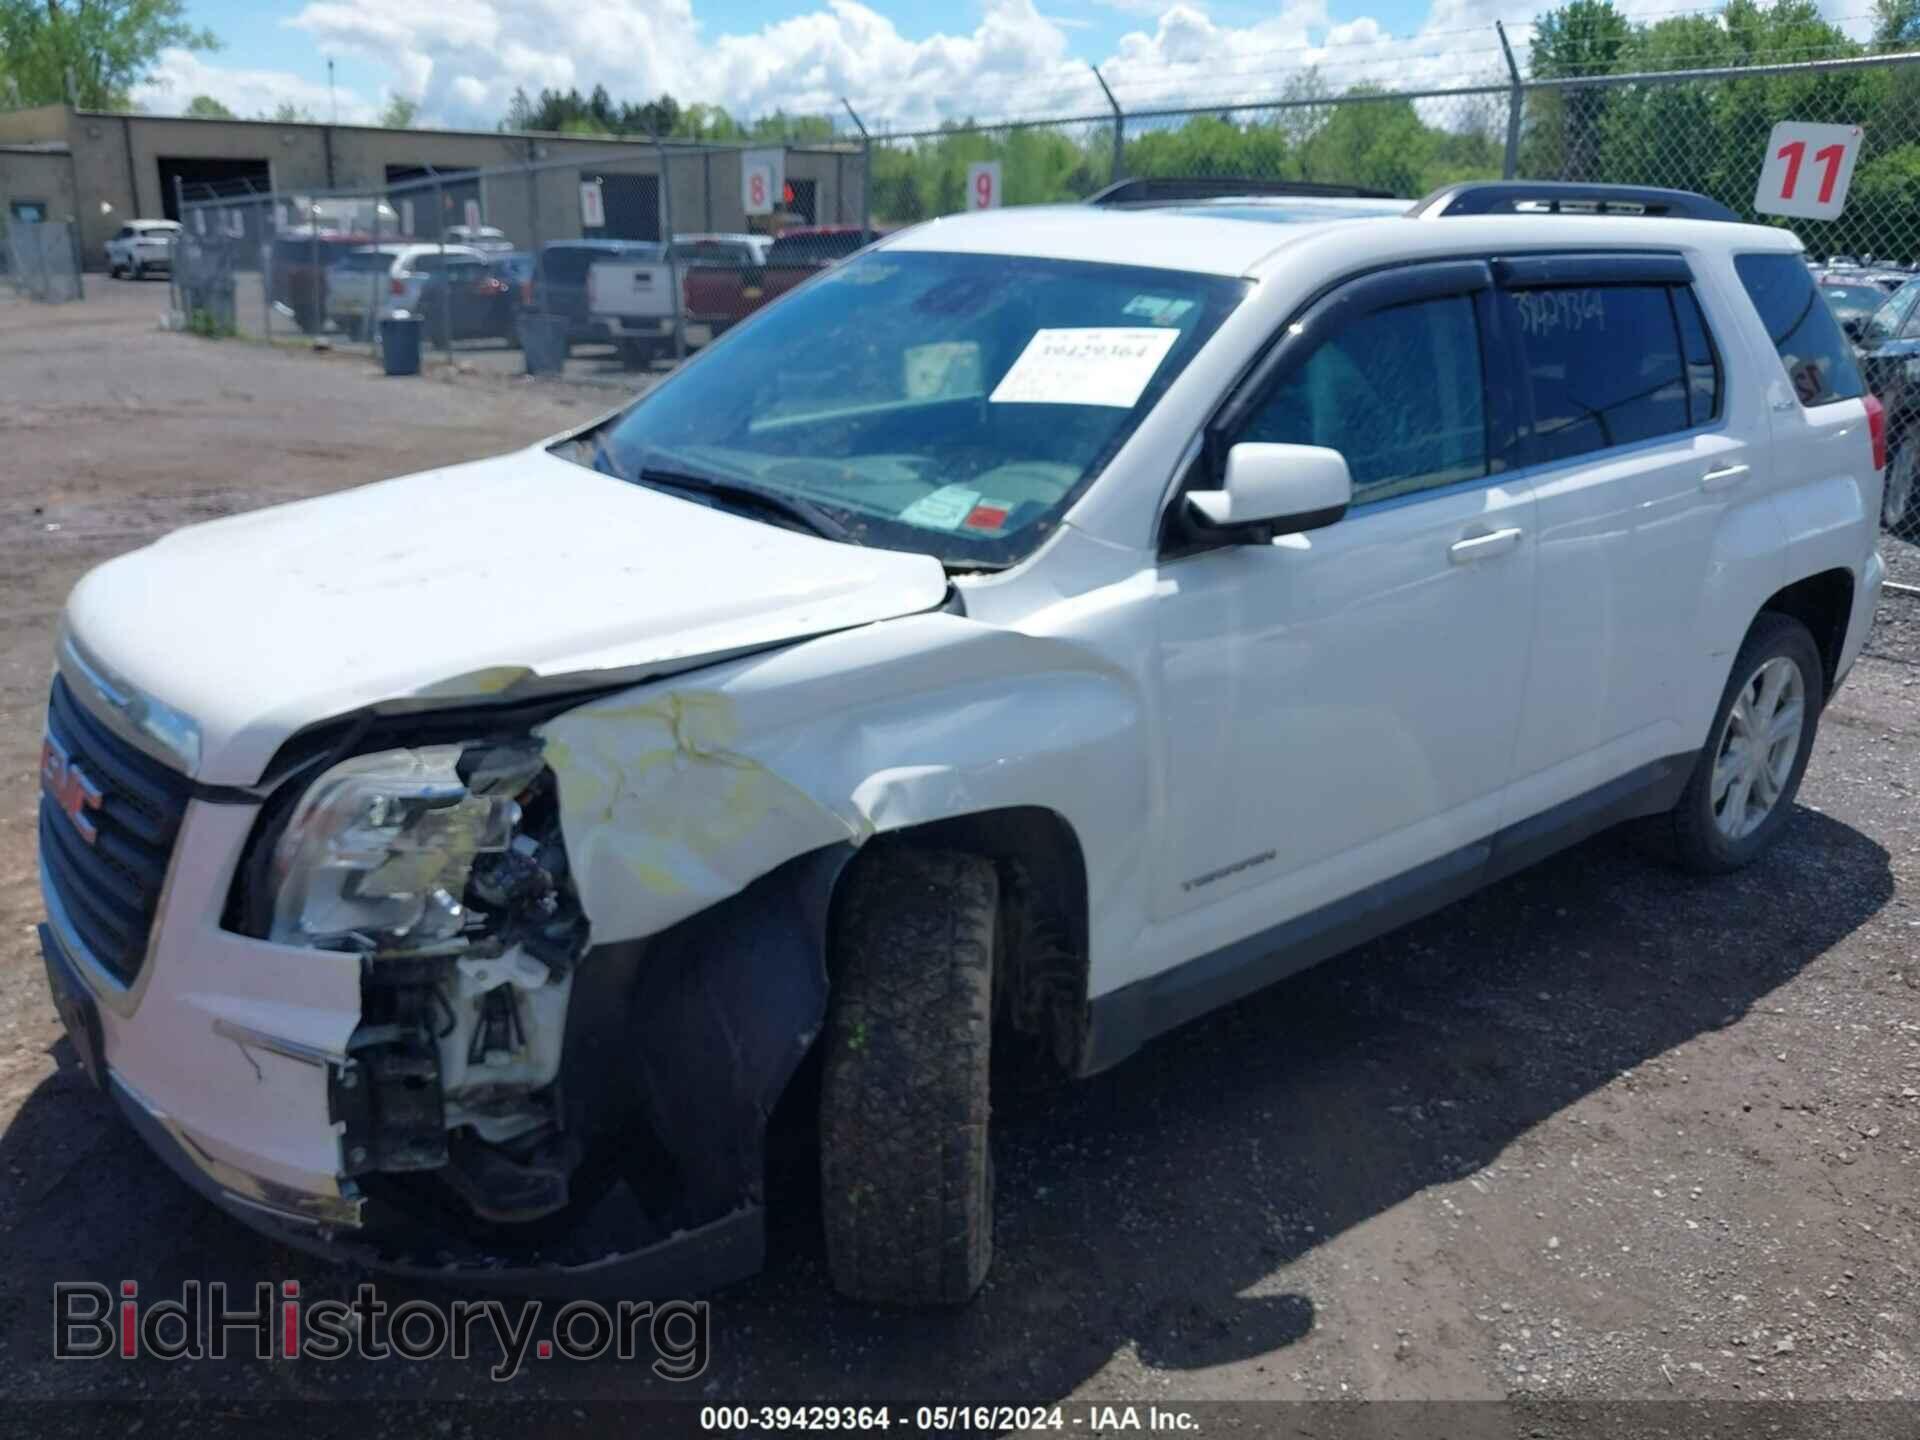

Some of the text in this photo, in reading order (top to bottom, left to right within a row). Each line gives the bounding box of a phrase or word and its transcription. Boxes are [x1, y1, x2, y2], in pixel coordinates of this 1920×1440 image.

[751, 175, 765, 207] 8
[976, 172, 992, 209] 9
[1777, 141, 1845, 204] 11
